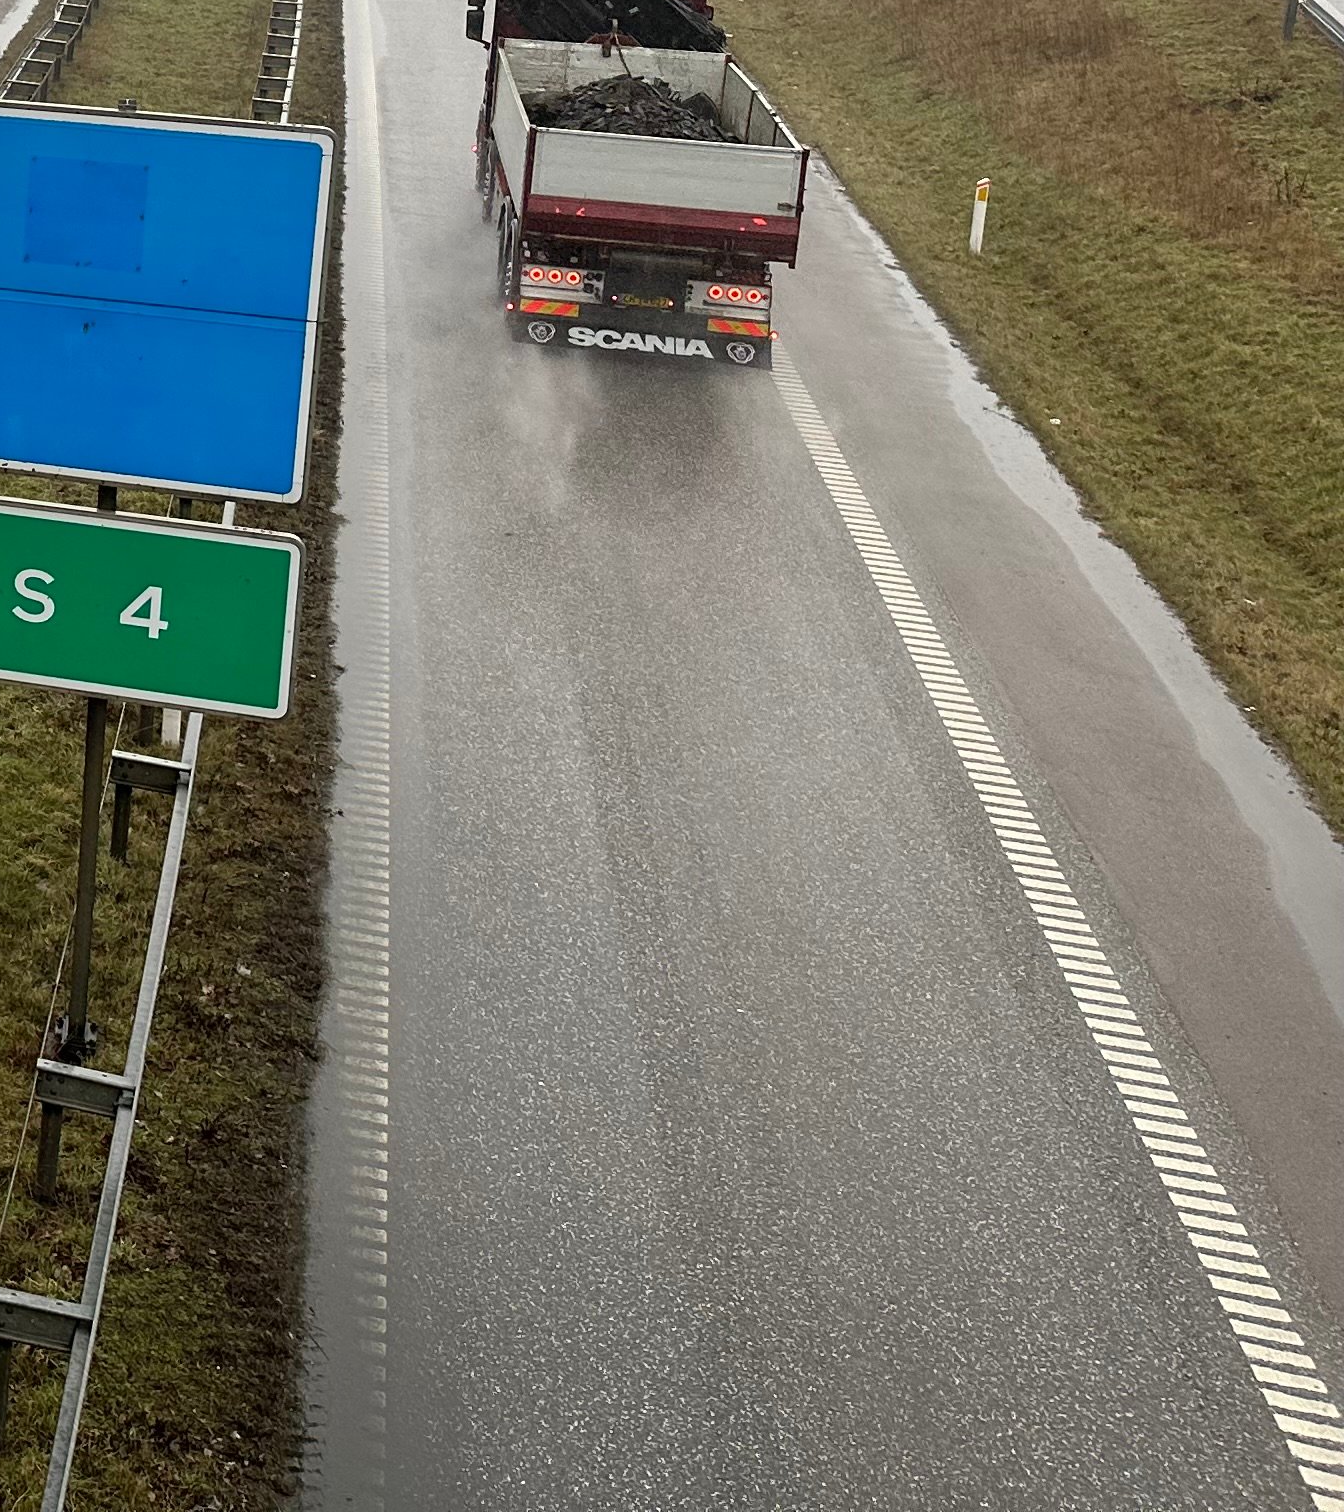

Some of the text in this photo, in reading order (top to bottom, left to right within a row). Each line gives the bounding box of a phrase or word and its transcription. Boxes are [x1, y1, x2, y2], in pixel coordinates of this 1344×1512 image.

[567, 326, 715, 359] SCANIA
[11, 567, 56, 624] S
[118, 585, 170, 640] 4
